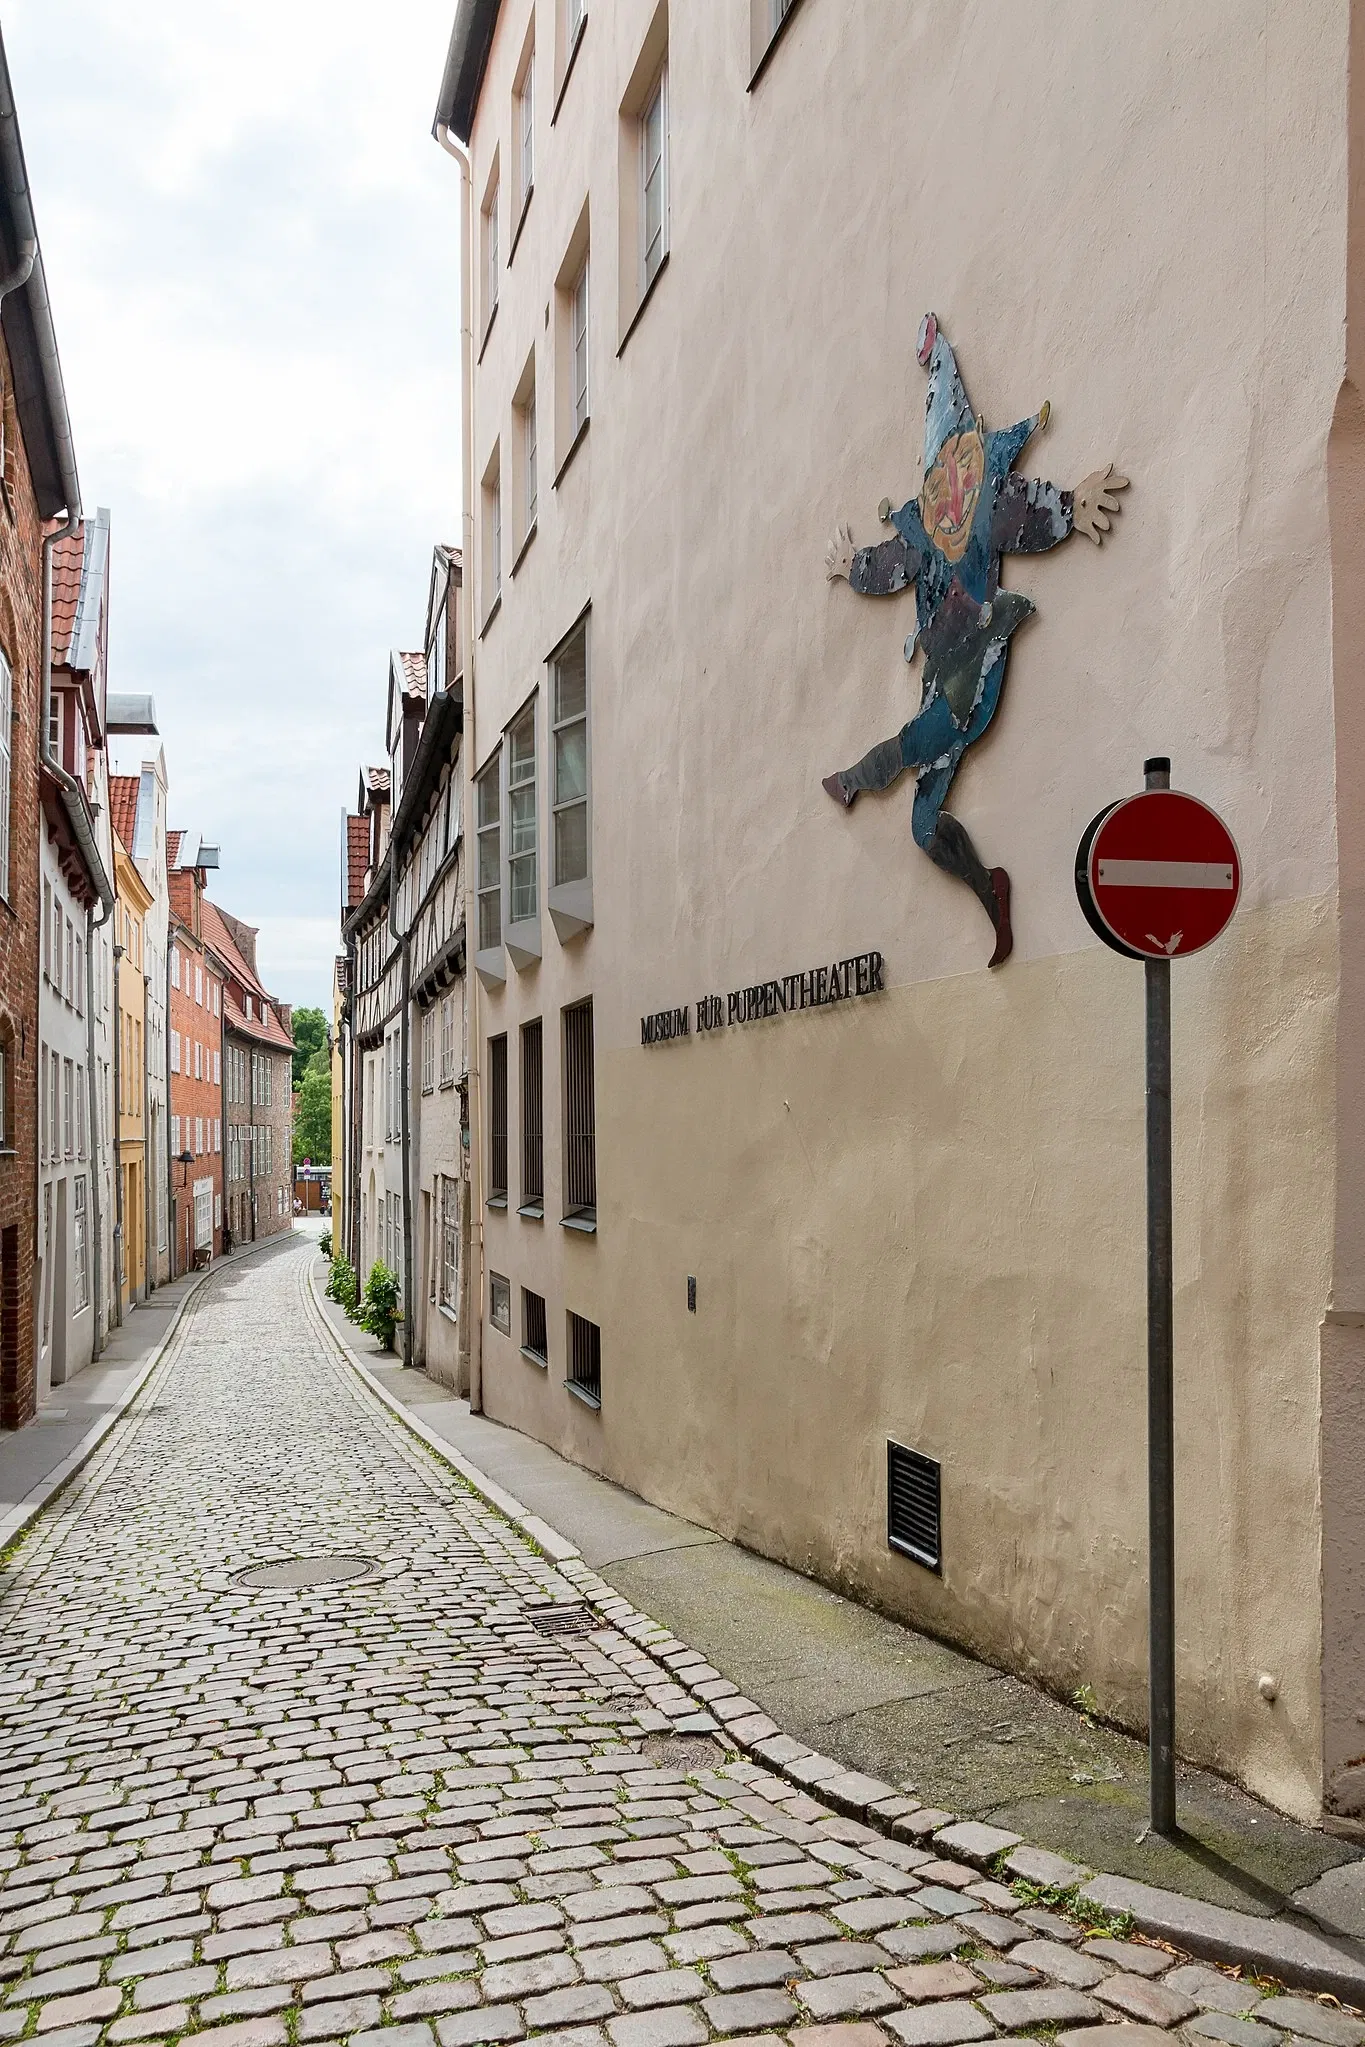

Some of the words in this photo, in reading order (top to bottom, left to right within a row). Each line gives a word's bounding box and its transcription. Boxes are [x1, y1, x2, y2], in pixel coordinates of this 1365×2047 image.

[640, 1005, 689, 1045] MUSEUM
[696, 994, 724, 1033] FÜR
[727, 951, 885, 1026] PUPPENTHEATER
